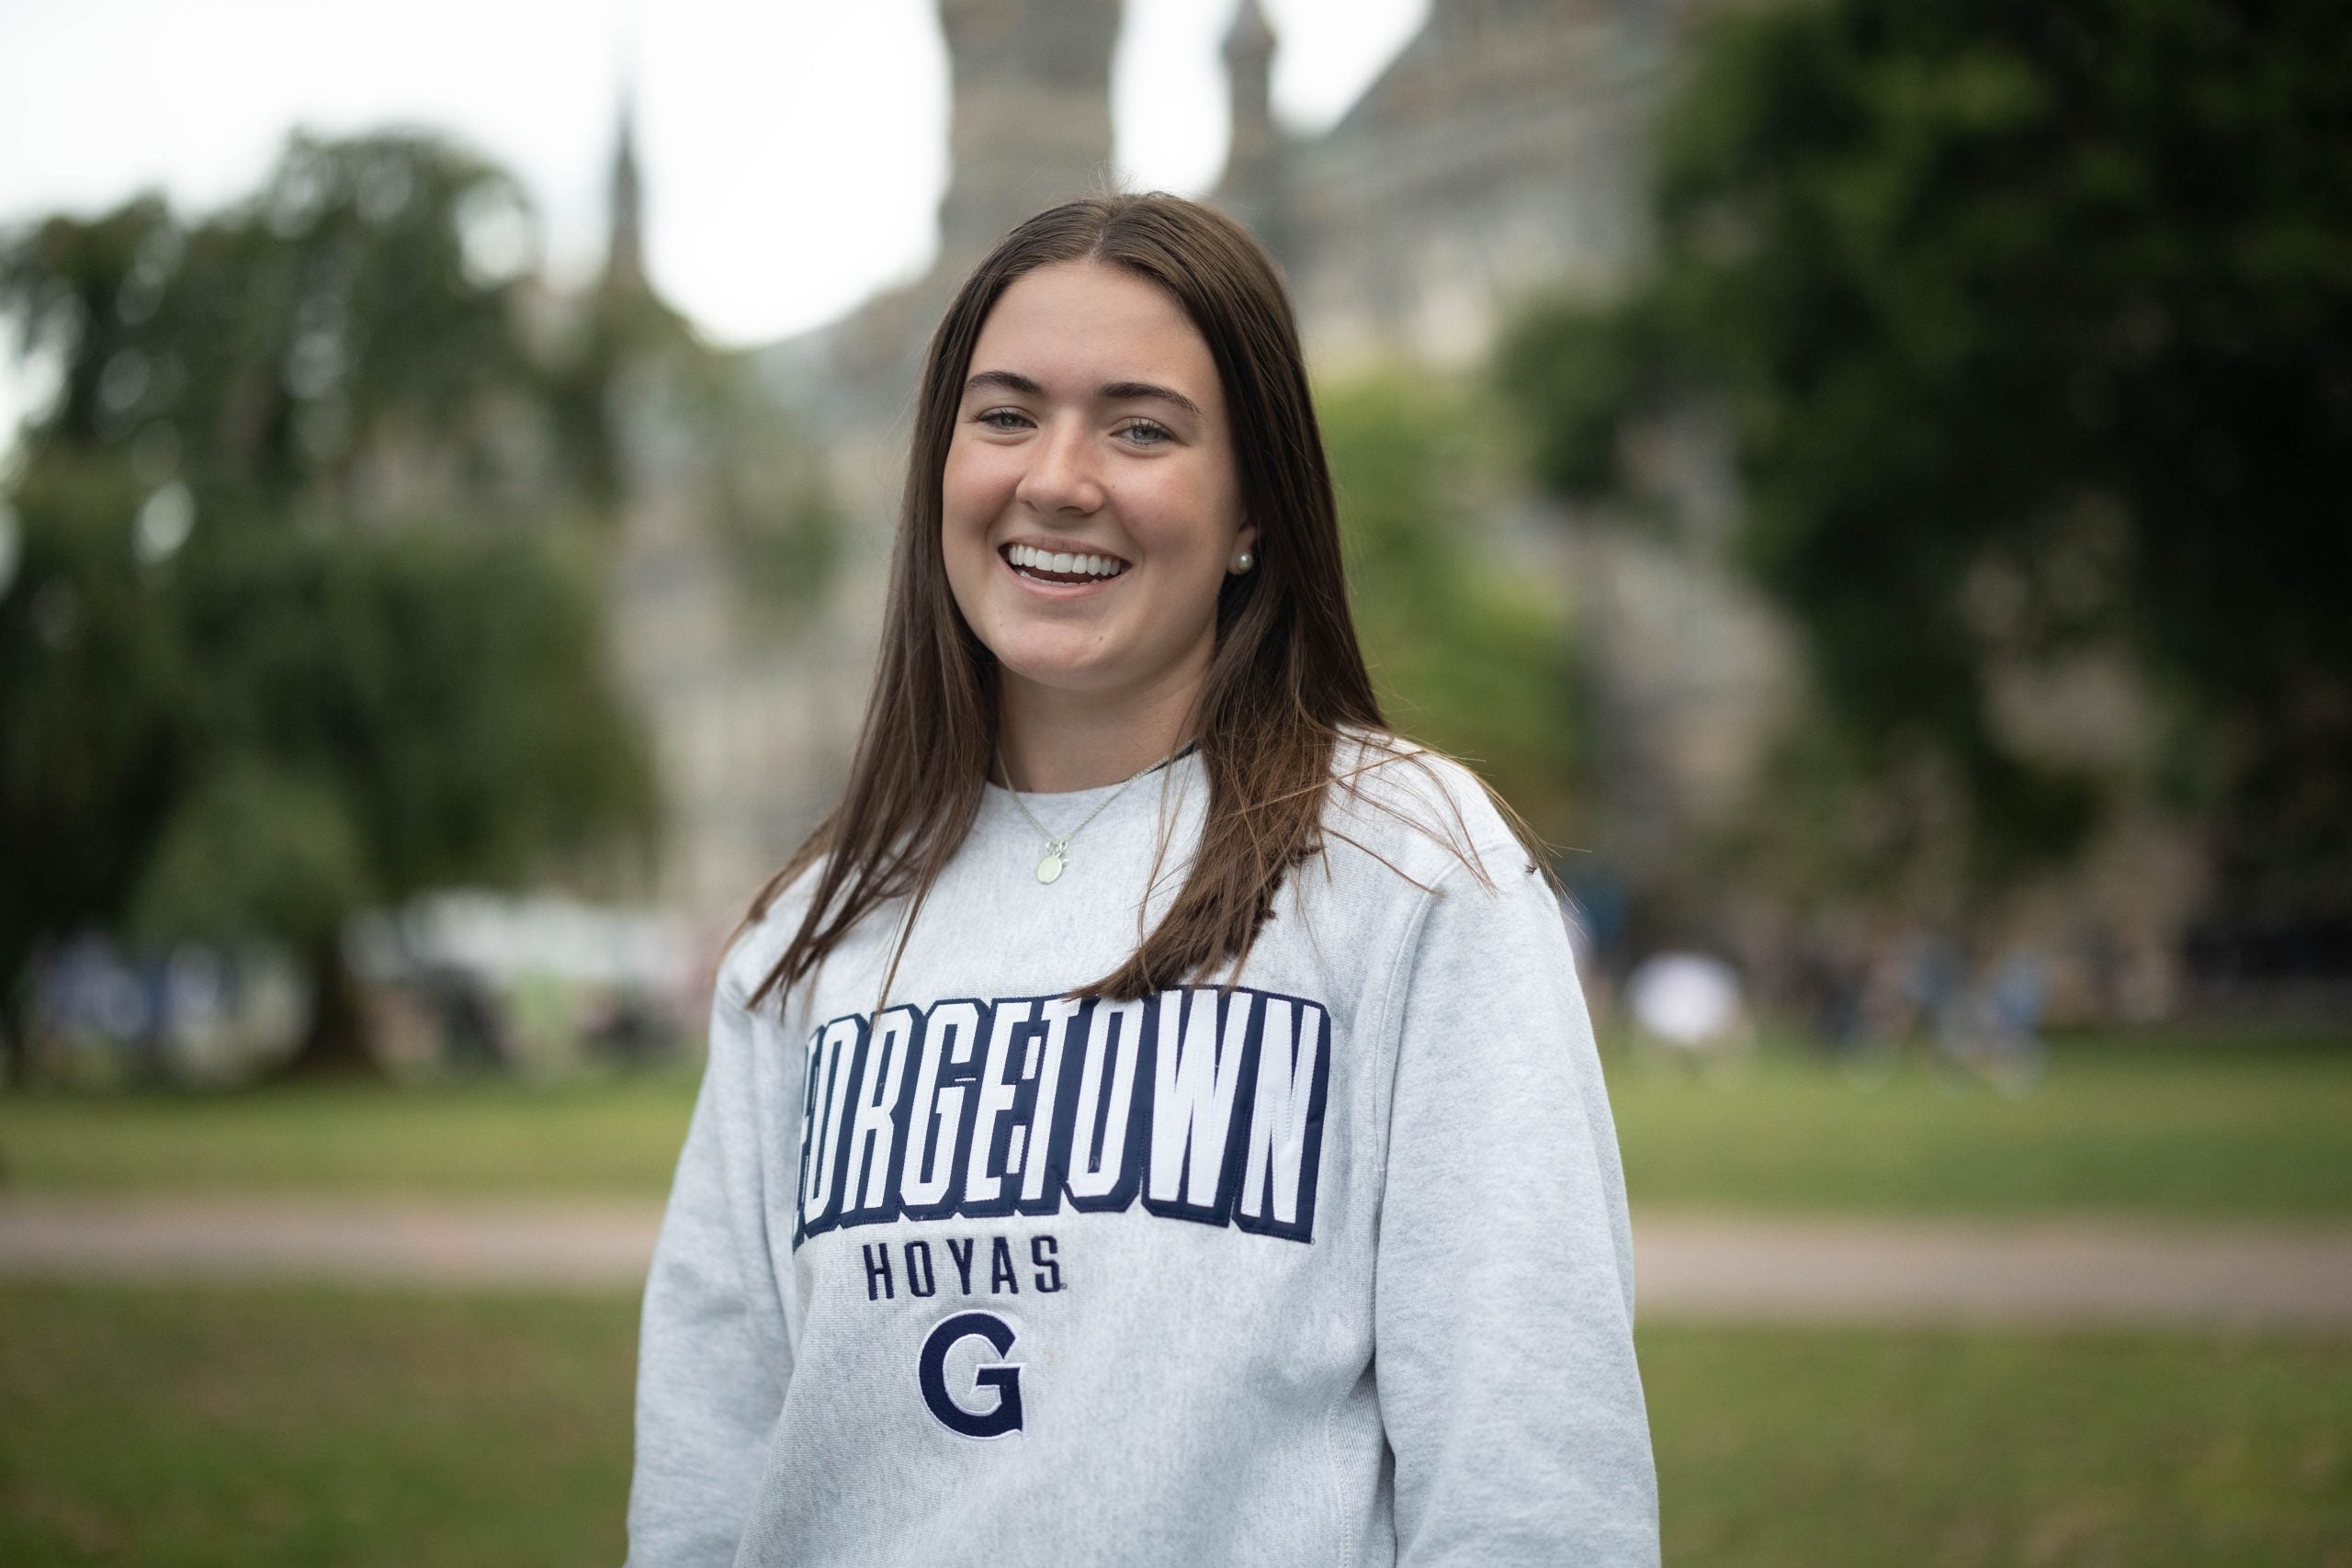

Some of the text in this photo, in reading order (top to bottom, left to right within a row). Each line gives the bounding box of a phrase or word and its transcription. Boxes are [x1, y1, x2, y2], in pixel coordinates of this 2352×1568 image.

[792, 984, 1331, 1256] EORGETOWN
[862, 1235, 1061, 1301] HOYAS
[917, 1309, 1026, 1440] G
